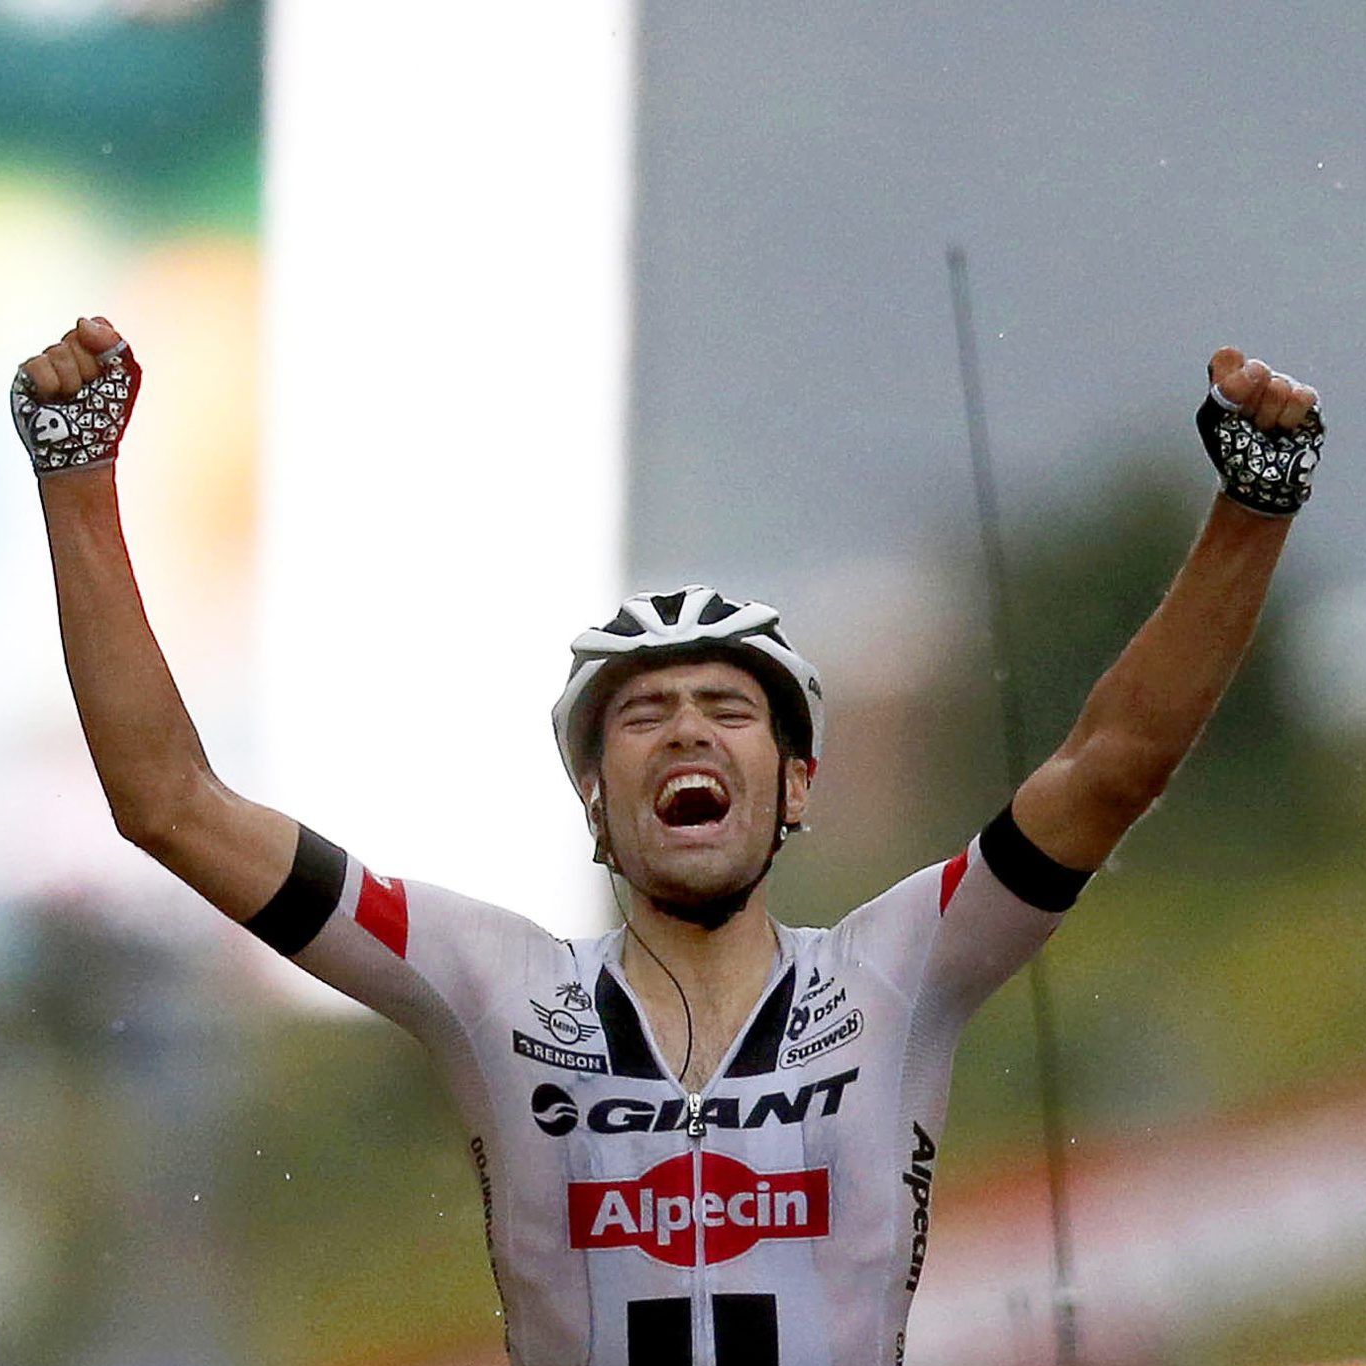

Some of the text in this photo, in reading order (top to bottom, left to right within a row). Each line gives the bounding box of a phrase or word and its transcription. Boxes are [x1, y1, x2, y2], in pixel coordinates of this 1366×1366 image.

[552, 1017, 578, 1036] MINI
[814, 987, 847, 1023] DSM
[533, 1043, 602, 1071] RENSON
[785, 1012, 859, 1065] Sunweb
[587, 1067, 860, 1134] GIANT
[590, 1181, 808, 1246] Alpecin
[902, 1120, 936, 1293] Alpecin
